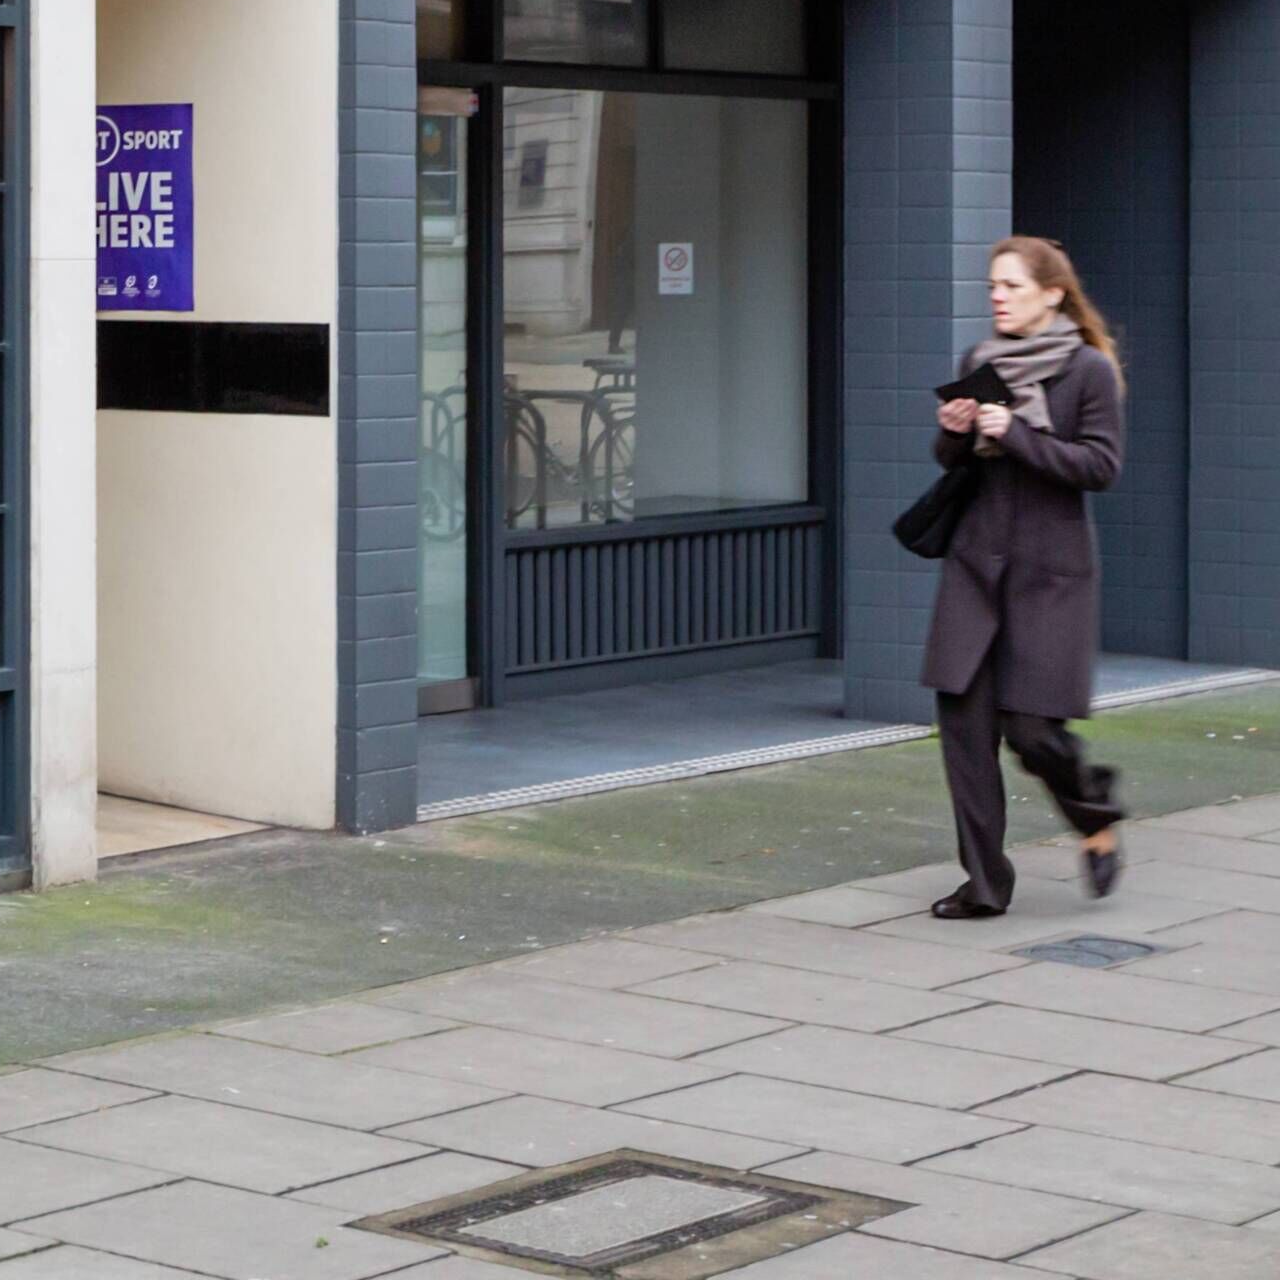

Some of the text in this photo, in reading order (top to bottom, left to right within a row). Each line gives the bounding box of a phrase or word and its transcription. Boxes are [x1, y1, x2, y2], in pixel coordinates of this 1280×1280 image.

[96, 129, 183, 151] T SPORT
[96, 171, 174, 211] IVE
